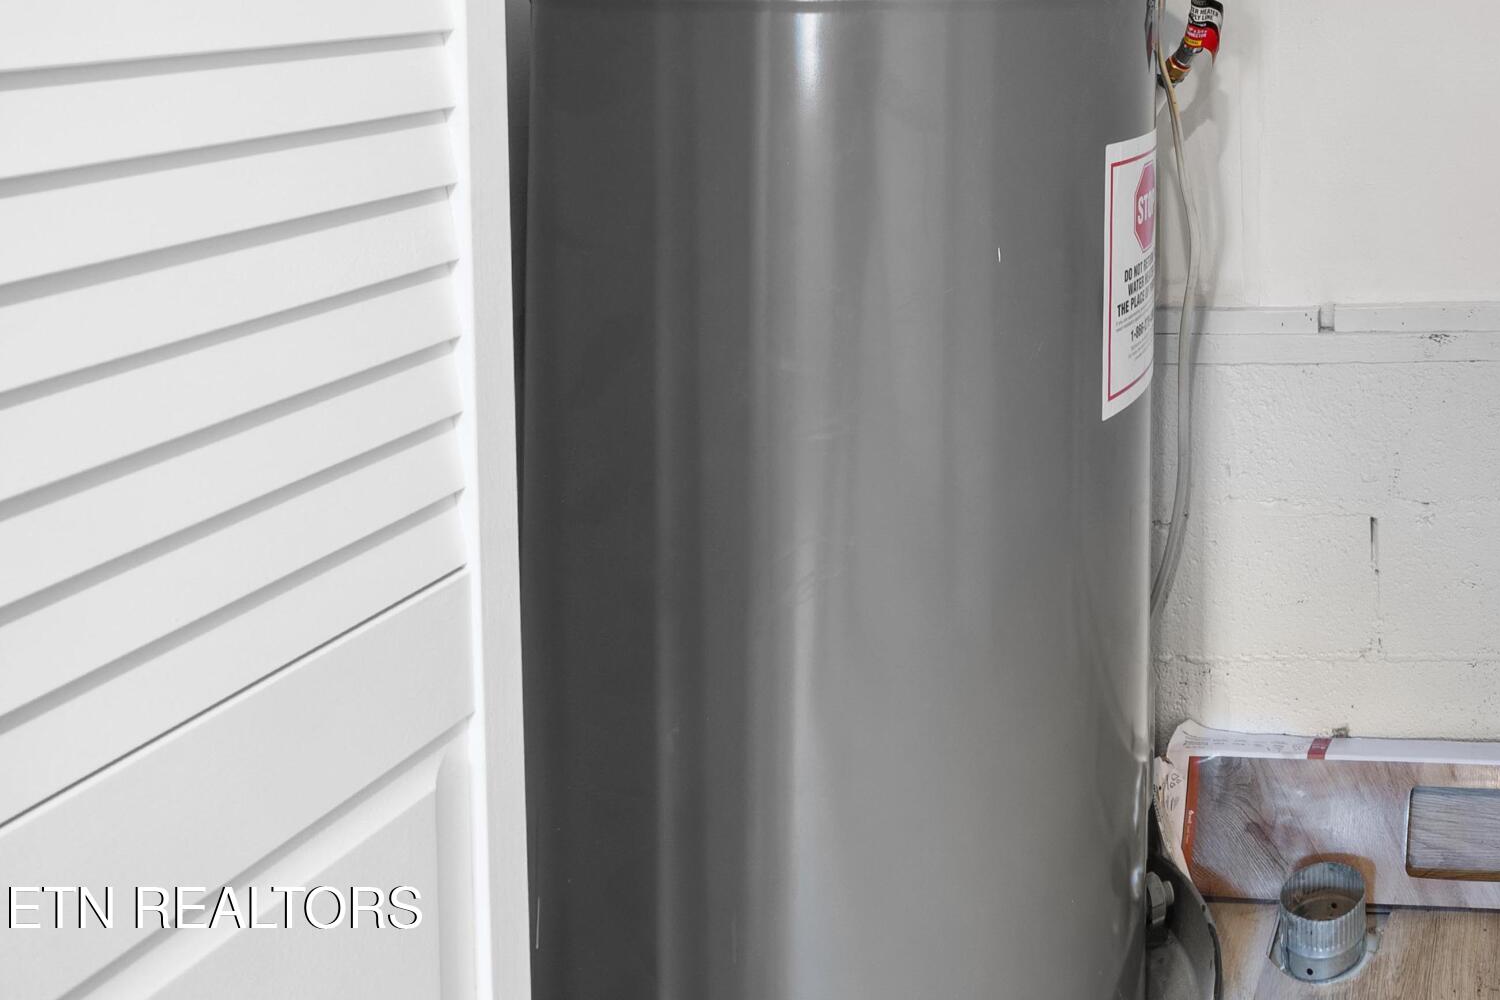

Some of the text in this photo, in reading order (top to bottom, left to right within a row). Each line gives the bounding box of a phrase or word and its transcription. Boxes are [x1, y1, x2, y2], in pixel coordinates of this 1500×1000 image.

[1124, 267, 1133, 282] DO
[1133, 261, 1143, 278] NOT
[1127, 275, 1144, 296] WATER
[1117, 300, 1130, 317] THE
[1130, 289, 1145, 311] PLACE
